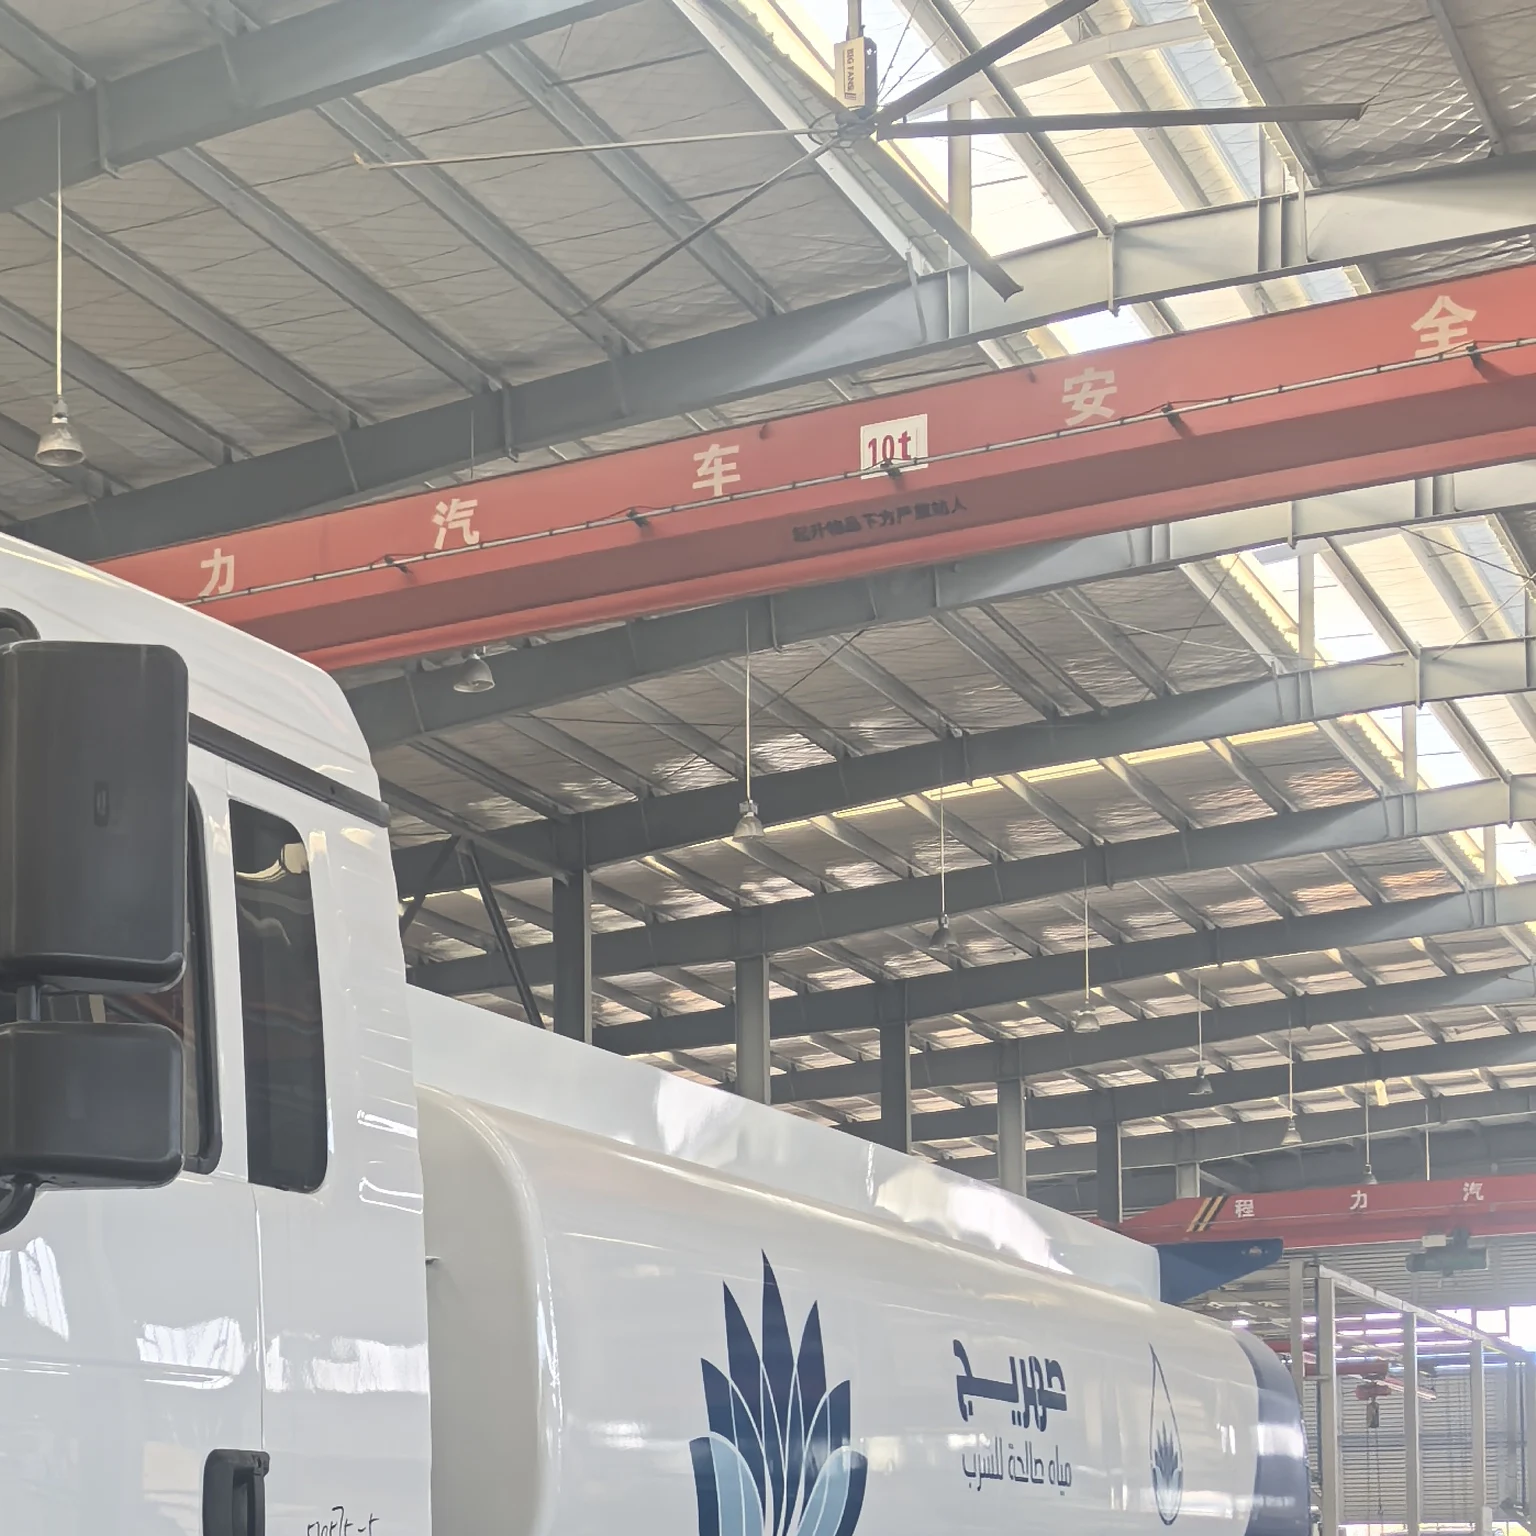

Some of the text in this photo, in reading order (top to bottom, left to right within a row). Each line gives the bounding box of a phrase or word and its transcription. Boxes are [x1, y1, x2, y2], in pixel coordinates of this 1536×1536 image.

[198, 295, 1477, 597] 力 汽 车 安 全
[868, 430, 912, 467] 10t
[1235, 1181, 1484, 1218] 程 力 汽
[1008, 1440, 1045, 1485] صالحة
[1048, 1444, 1072, 1496] مياه
